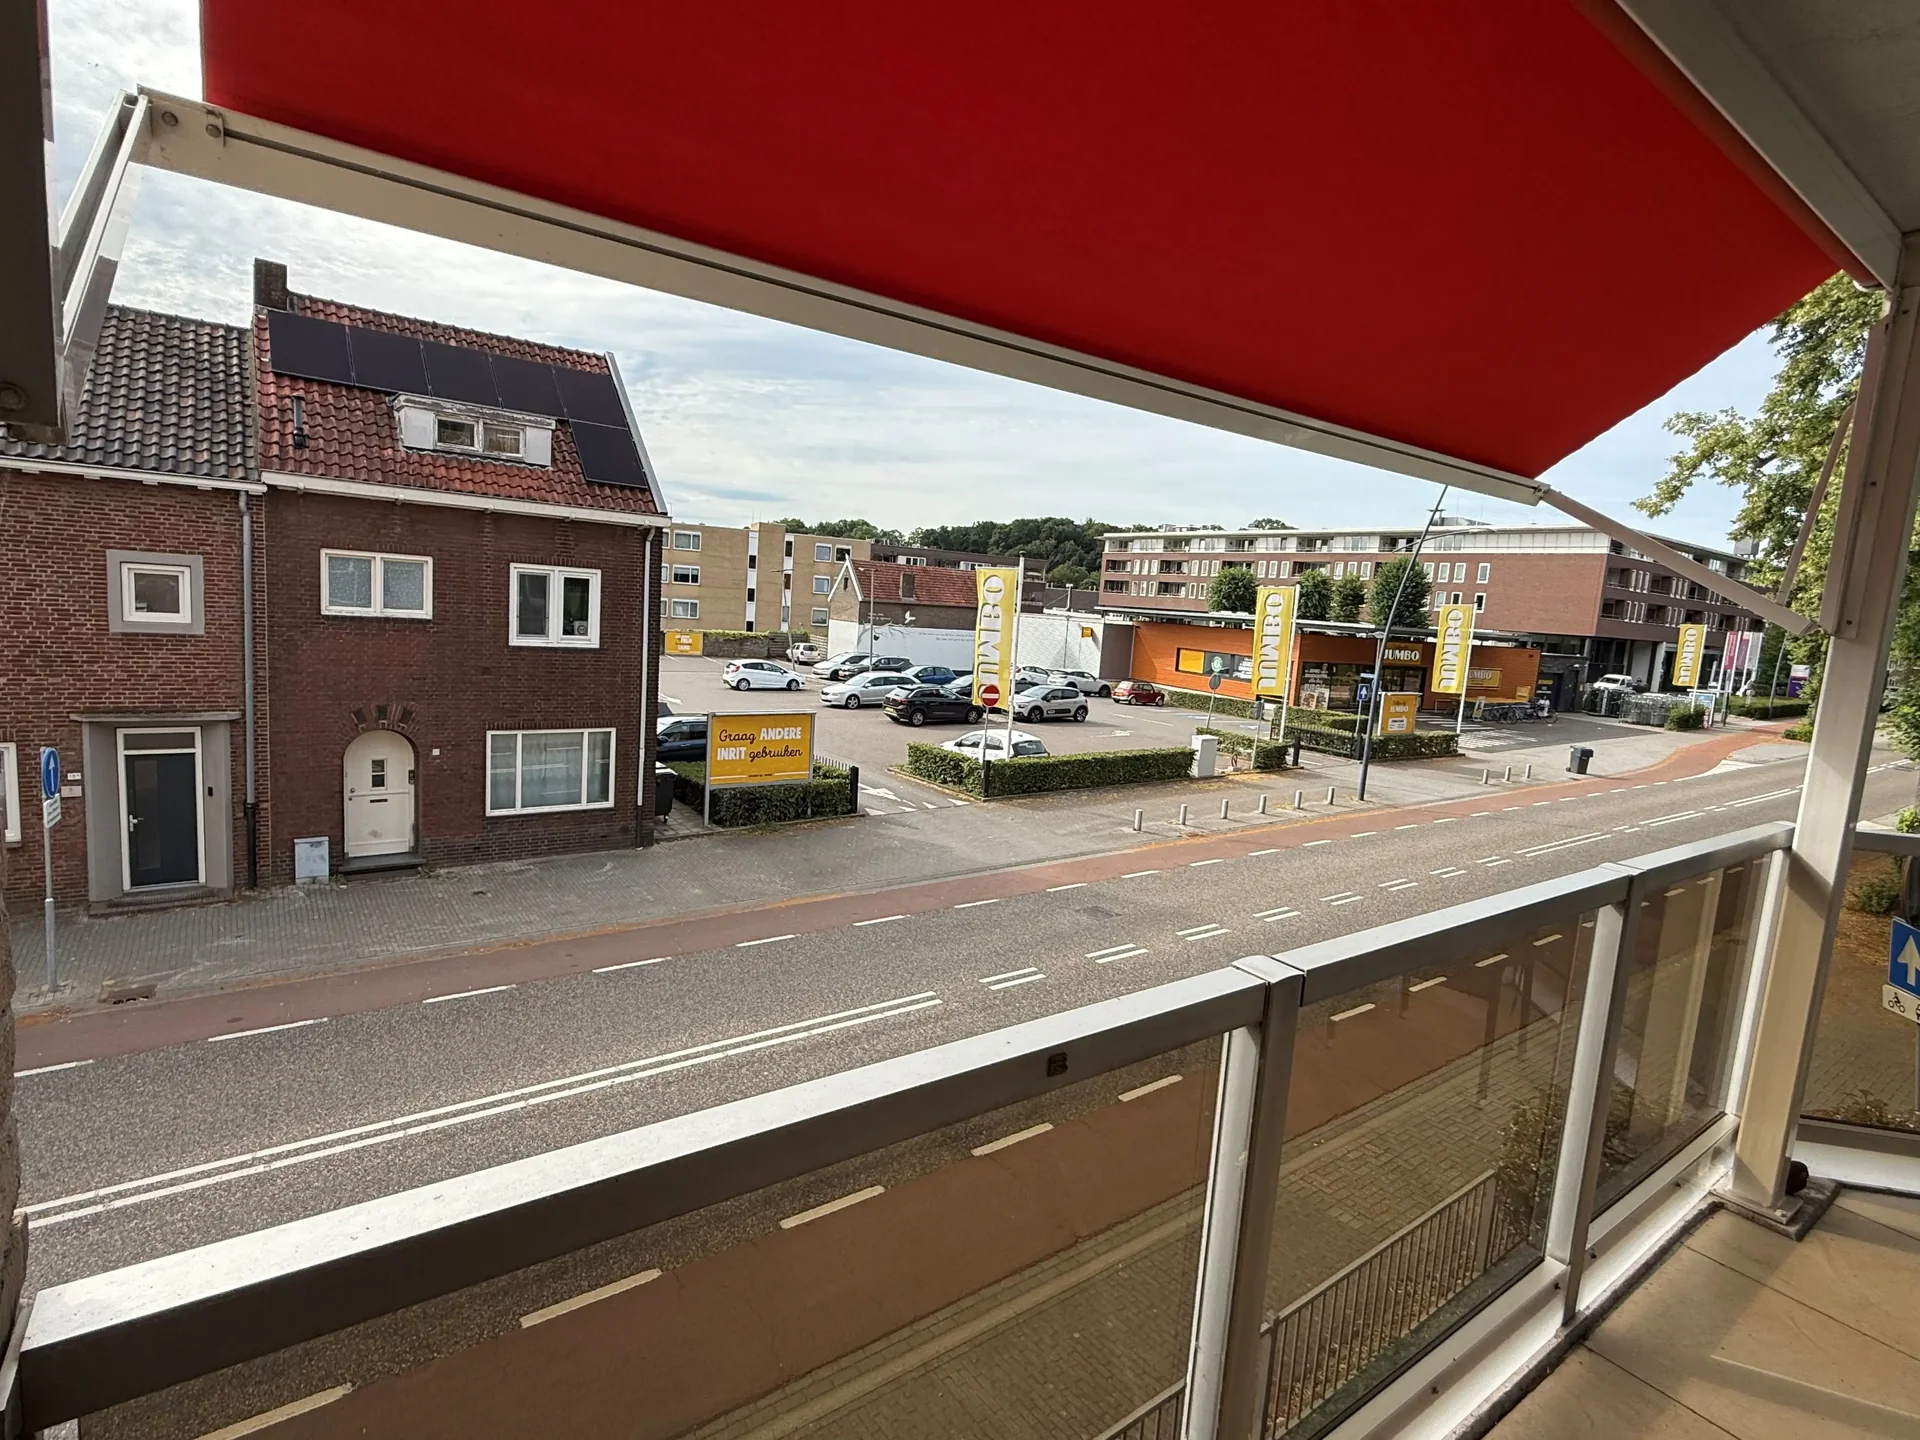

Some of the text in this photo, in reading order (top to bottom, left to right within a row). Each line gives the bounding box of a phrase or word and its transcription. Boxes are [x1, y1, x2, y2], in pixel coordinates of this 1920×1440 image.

[977, 574, 1005, 704] UMBO
[1257, 592, 1284, 690] JUMBO
[1383, 648, 1420, 661] JUMBO
[1438, 608, 1463, 690] JUMBO
[1678, 627, 1699, 684] JUMBO
[1469, 669, 1492, 680] UMBO
[716, 745, 803, 763] INRIT gebruiken
[719, 727, 802, 745] Graag ANDERE
